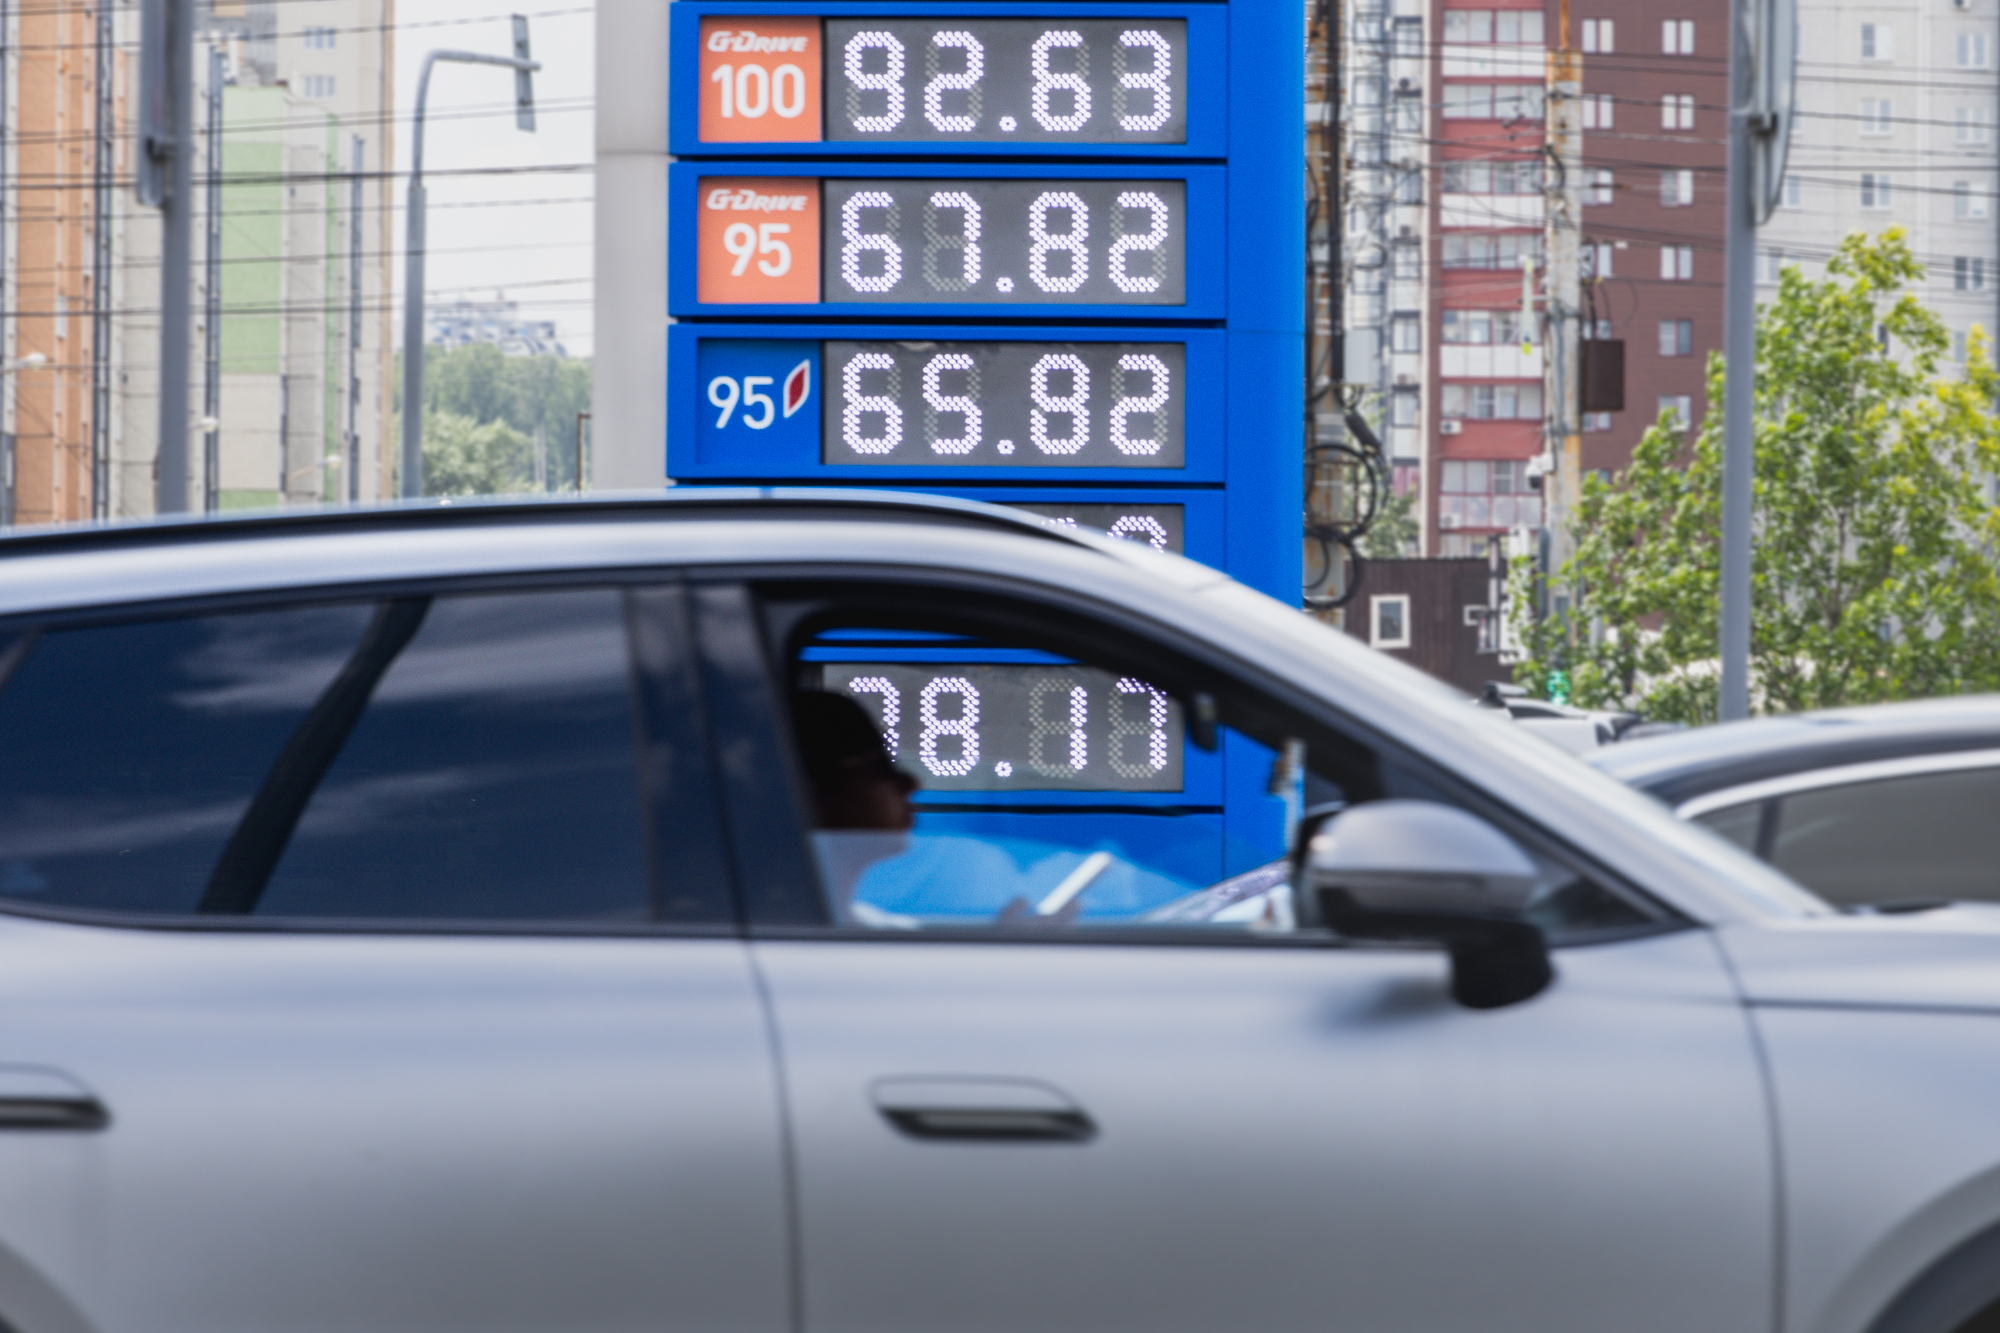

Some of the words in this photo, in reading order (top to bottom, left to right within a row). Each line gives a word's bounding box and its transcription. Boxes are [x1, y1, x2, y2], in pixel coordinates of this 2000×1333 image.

[711, 63, 806, 118] 100
[844, 30, 1171, 132] 92.63
[723, 222, 792, 277] 95
[842, 191, 1169, 292] 67.82
[707, 375, 775, 429] 95
[842, 353, 1170, 455] 65.82
